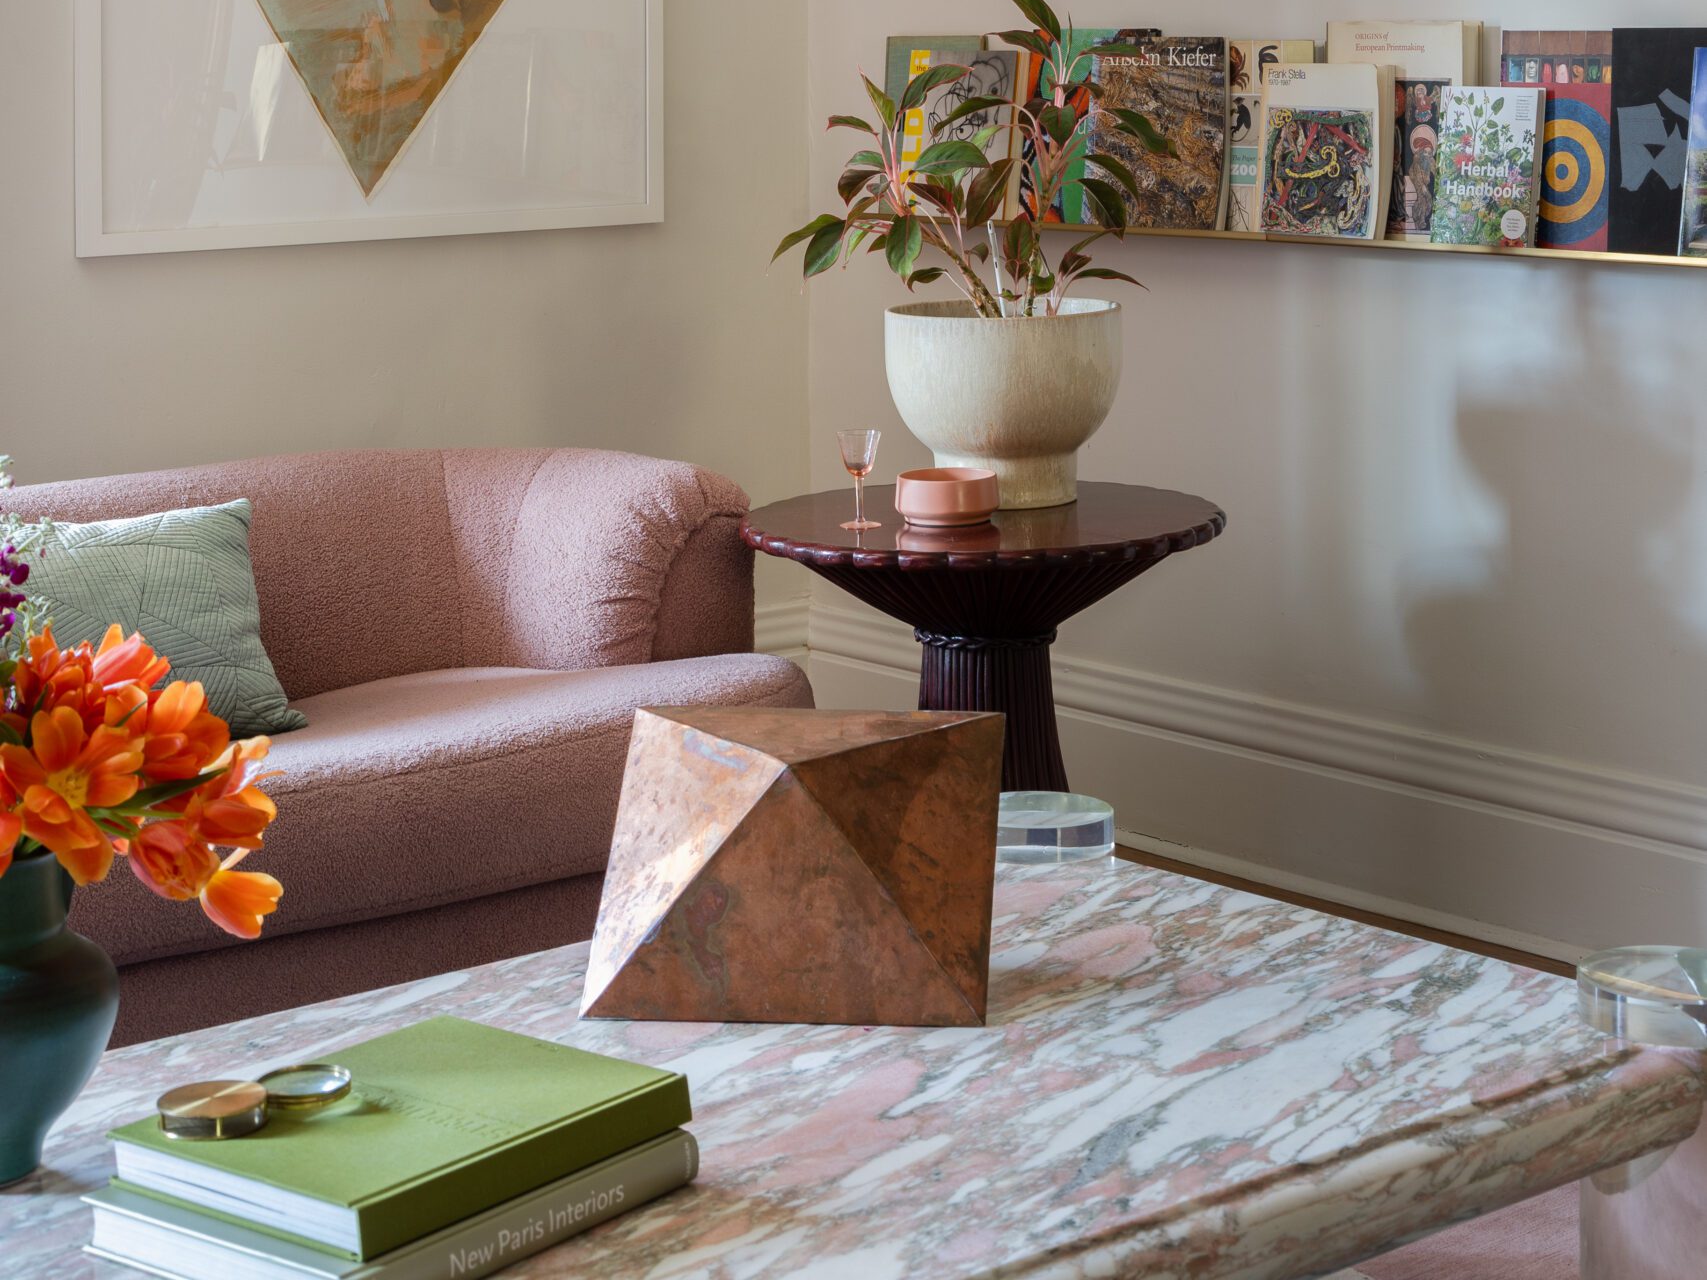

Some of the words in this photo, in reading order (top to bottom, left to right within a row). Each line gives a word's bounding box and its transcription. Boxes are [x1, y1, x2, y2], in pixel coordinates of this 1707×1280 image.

[1354, 32, 1384, 40] ORIGINS
[1167, 45, 1217, 67] Kiefer
[1355, 42, 1386, 54] European
[1386, 42, 1425, 53] Printmaking
[1268, 68, 1287, 80] Frank
[1288, 68, 1306, 80] Stella
[1461, 160, 1509, 177] Herbal
[1446, 180, 1521, 198] Handbook
[449, 1240, 494, 1278] New
[497, 1219, 544, 1257] Paris
[549, 1183, 625, 1232] Interiors
